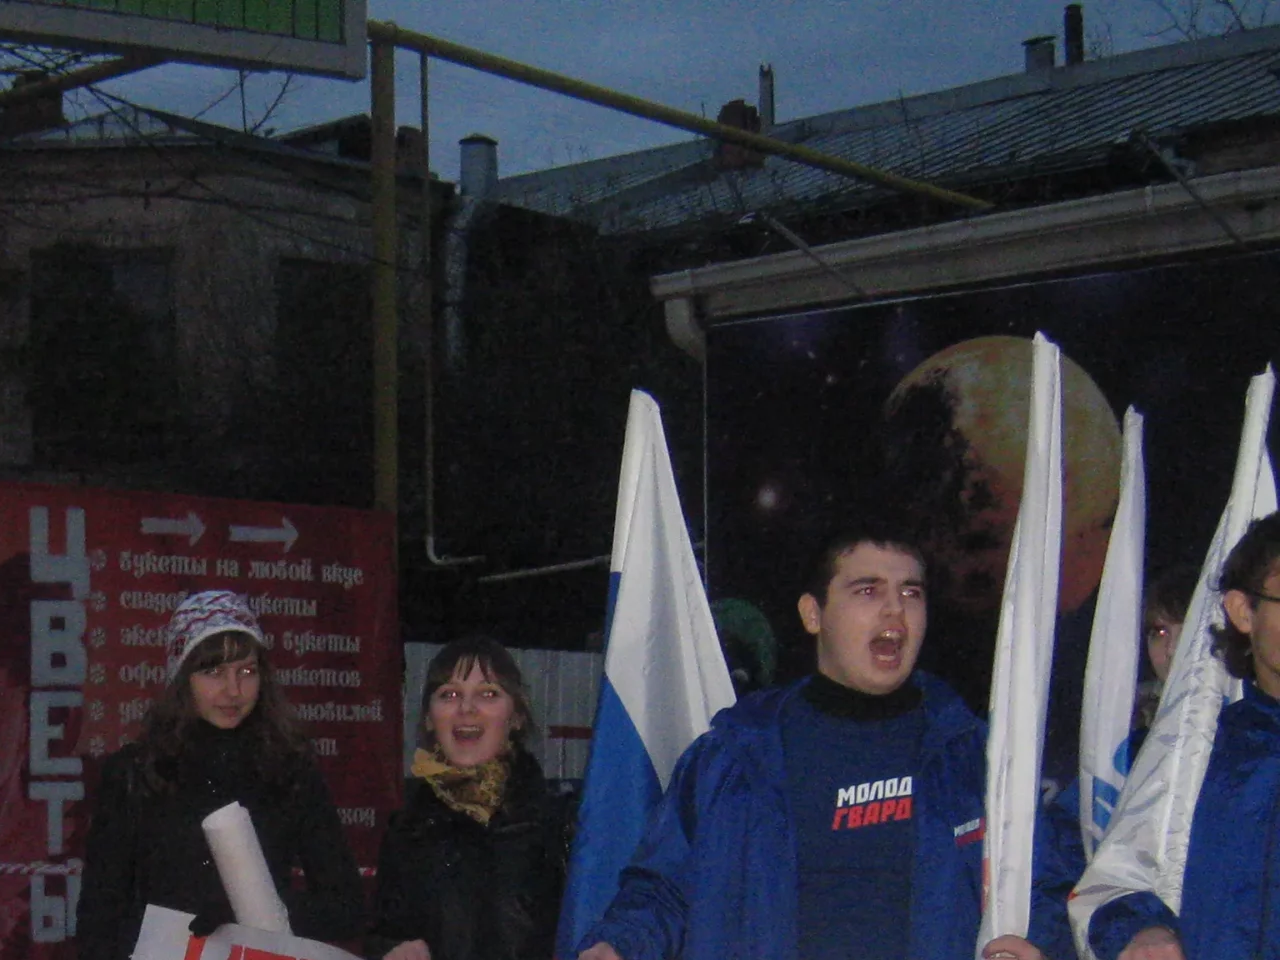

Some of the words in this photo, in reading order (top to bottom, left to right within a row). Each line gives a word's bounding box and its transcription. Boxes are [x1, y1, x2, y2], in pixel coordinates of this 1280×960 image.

[120, 550, 207, 578] букеты
[216, 559, 239, 577] на
[248, 558, 314, 582] любой
[283, 629, 361, 656] букеты
[29, 506, 91, 942] ЦВЕТЫ
[837, 776, 913, 807] МОЛОД
[831, 797, 913, 831] ГВАРД
